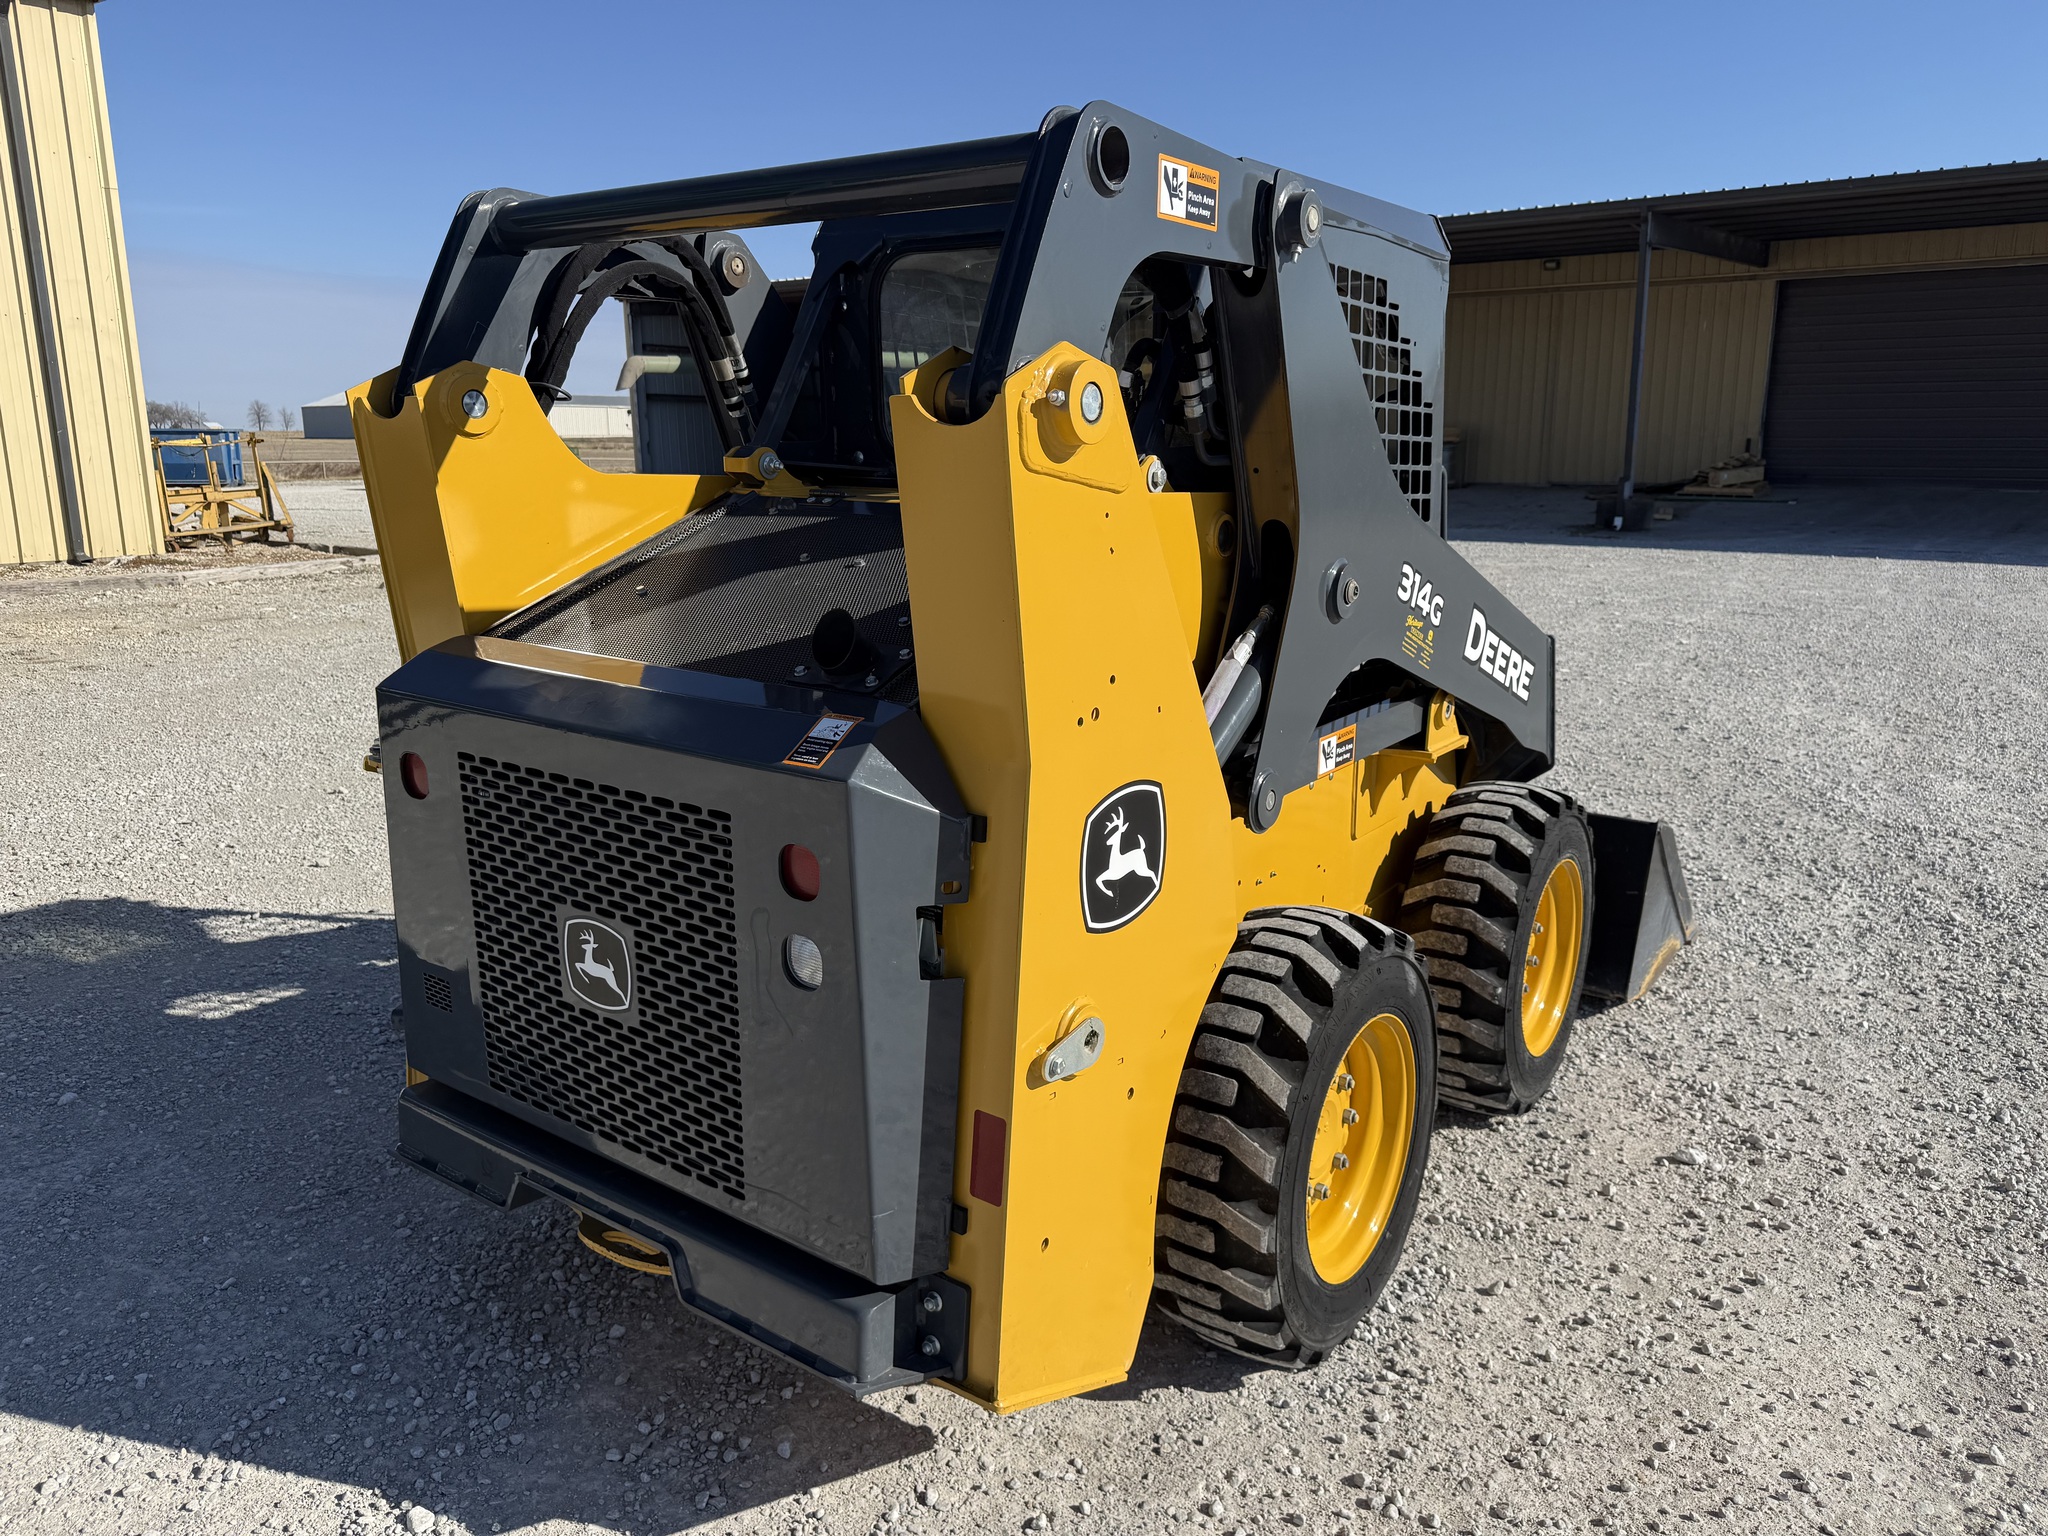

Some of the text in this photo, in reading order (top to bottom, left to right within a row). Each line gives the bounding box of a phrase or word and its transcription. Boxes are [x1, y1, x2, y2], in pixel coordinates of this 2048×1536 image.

[1194, 172, 1217, 185] WARNING
[1188, 190, 1215, 206] Pinch Area
[1188, 204, 1211, 219] Keep Away
[1397, 563, 1445, 627] 314G
[1464, 608, 1535, 702] DEERE
